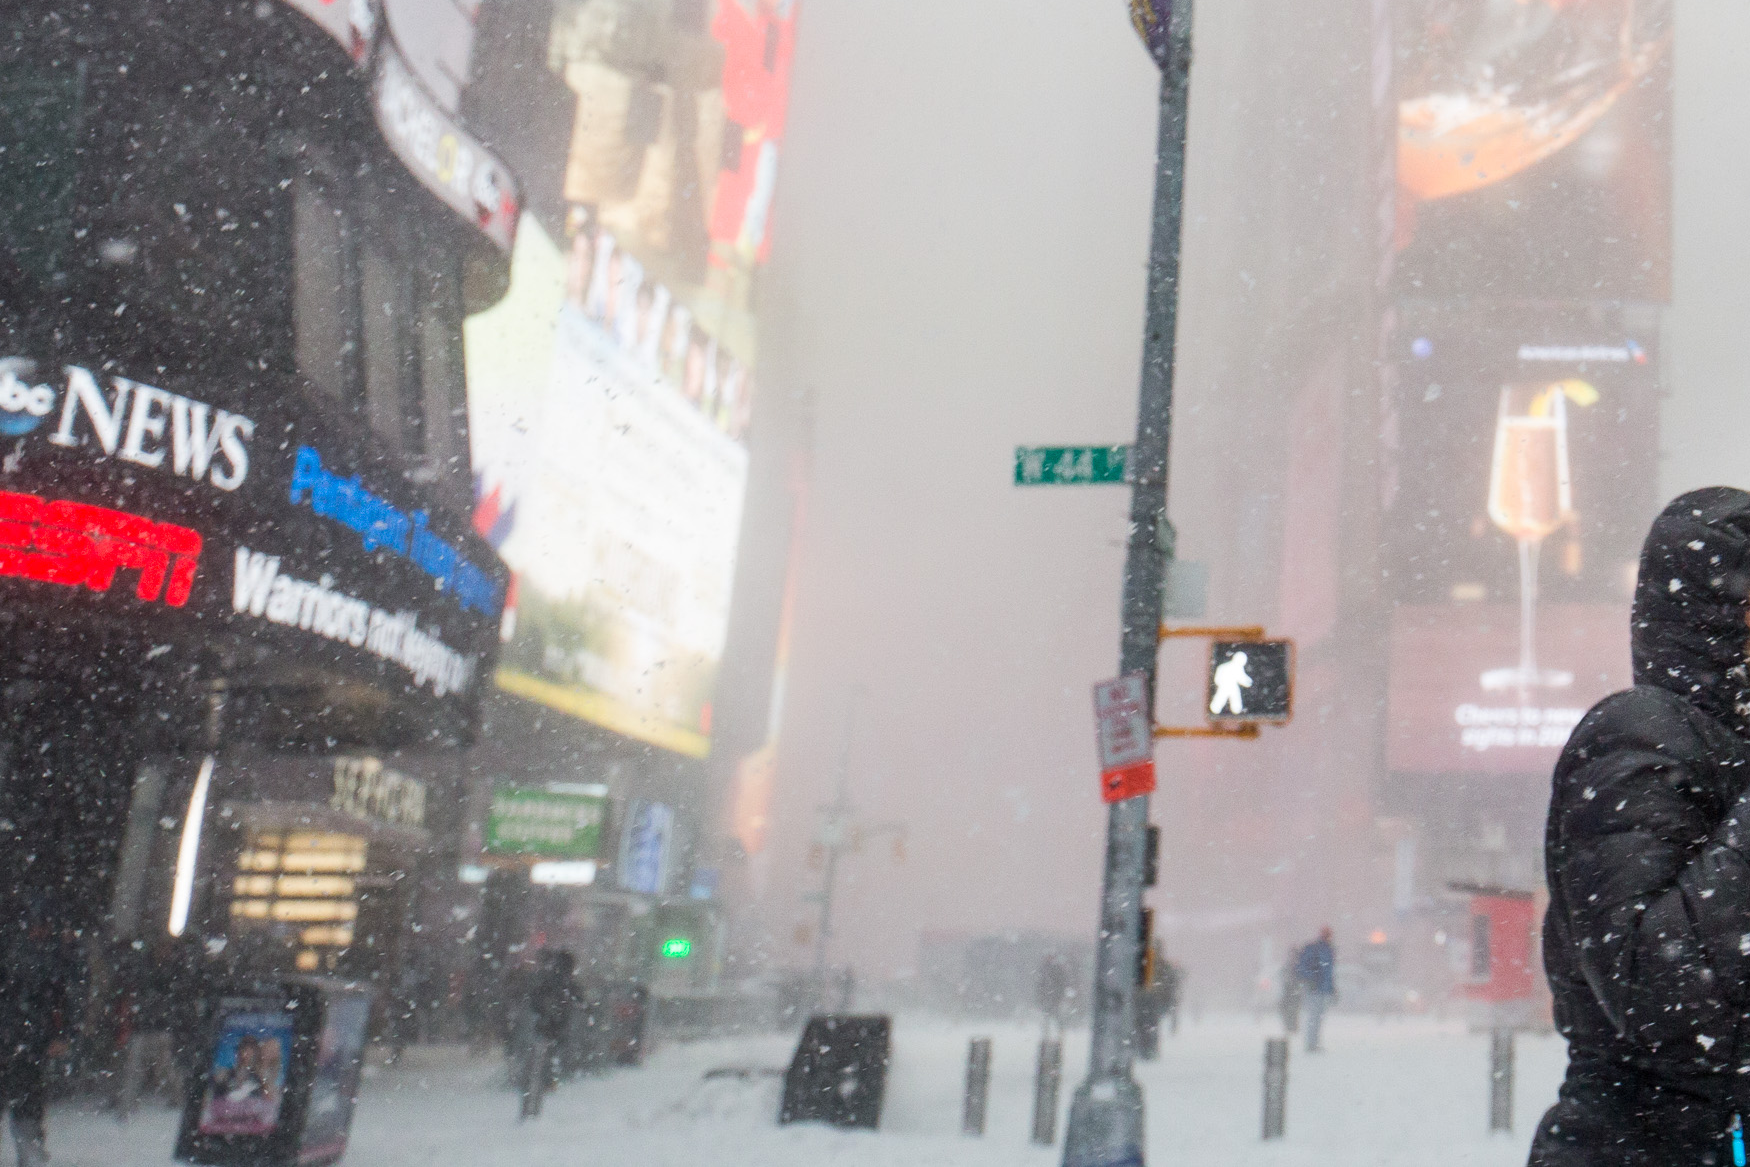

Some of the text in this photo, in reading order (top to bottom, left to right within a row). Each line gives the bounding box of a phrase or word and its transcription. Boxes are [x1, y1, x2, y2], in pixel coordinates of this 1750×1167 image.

[48, 365, 256, 493] NEWS
[1053, 448, 1093, 482] 44
[233, 545, 371, 647] Warriors
